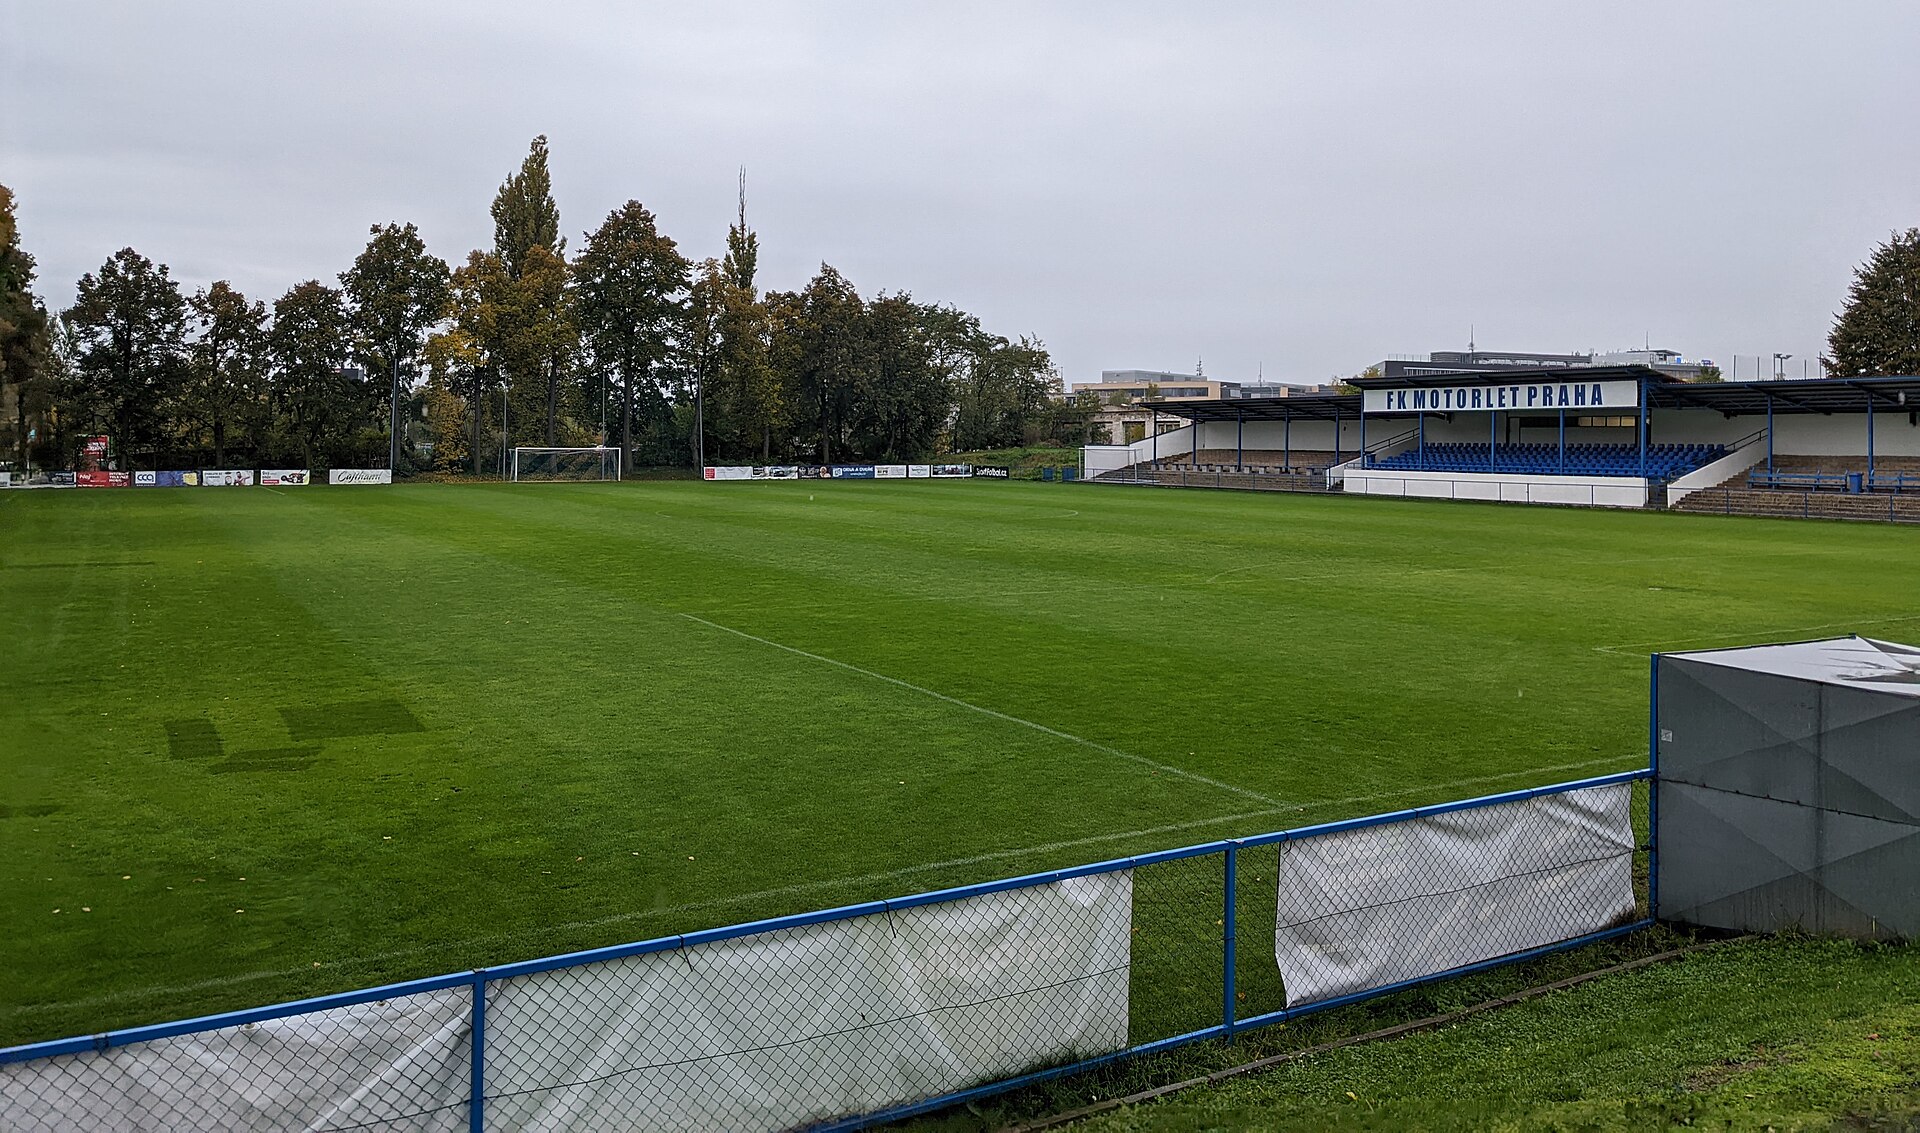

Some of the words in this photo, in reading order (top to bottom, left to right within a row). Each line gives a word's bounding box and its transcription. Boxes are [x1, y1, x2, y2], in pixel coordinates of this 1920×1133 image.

[1386, 389, 1407, 410] FK
[1413, 387, 1519, 409] MOTORLET
[1527, 384, 1603, 407] PRAHA
